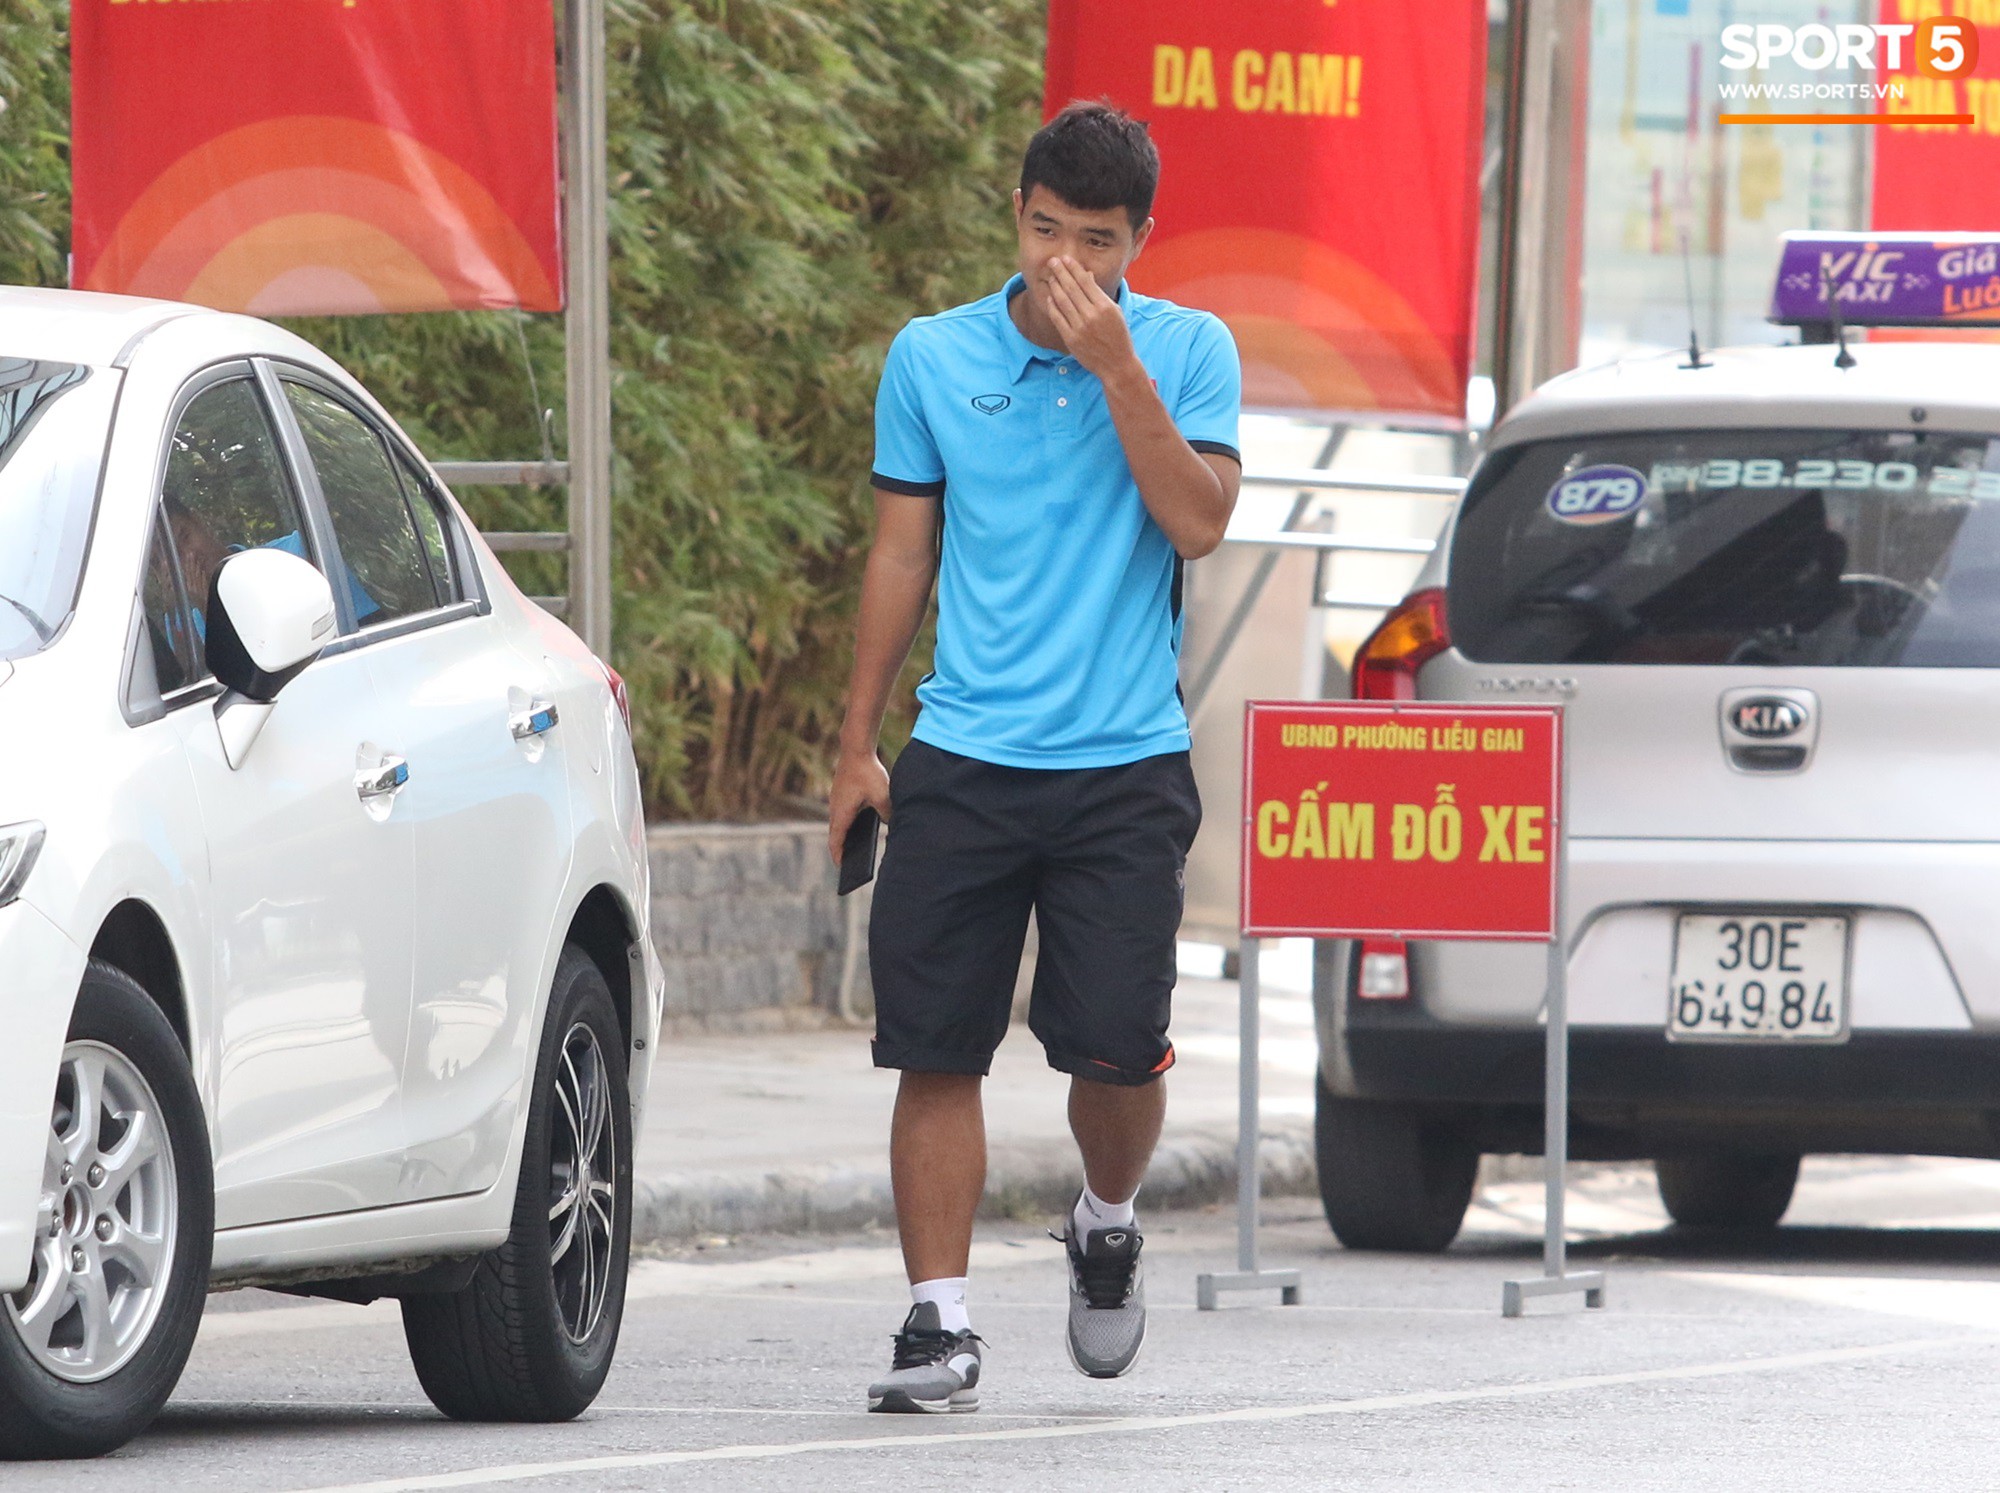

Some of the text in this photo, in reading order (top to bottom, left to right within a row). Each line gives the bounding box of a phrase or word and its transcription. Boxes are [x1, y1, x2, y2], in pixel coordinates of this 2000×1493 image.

[1153, 44, 1362, 117] DA CAM!
[1556, 476, 1641, 512] 879
[1281, 724, 1339, 748] UBND
[1343, 720, 1427, 749] PHƯỜNG
[1482, 728, 1524, 752] GIAI
[1740, 706, 1795, 732] KIA
[1257, 780, 1545, 863] CẤM ĐỖ XE
[1717, 921, 1806, 972] 30E
